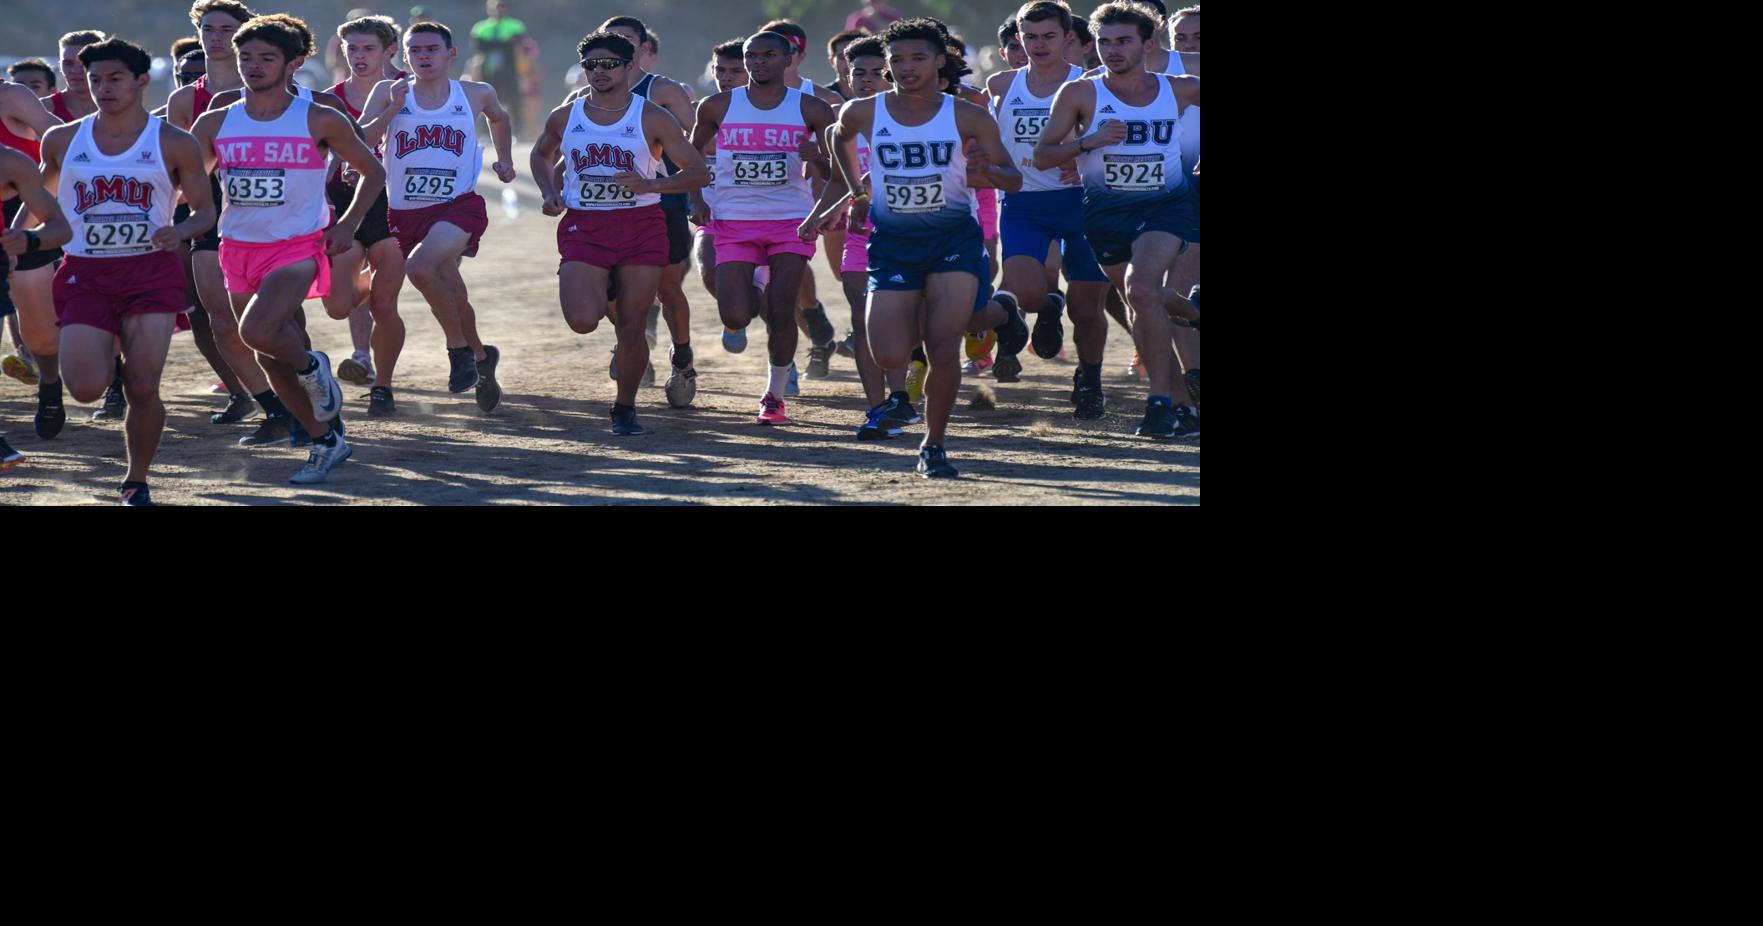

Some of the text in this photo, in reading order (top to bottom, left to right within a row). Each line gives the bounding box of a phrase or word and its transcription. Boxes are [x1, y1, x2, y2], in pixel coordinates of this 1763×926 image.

[395, 124, 466, 159] LMU
[722, 128, 804, 147] MT. SAC
[1098, 119, 1176, 146] BU
[218, 142, 311, 164] MT. SAC
[571, 143, 635, 174] LMU
[876, 141, 956, 170] CBU
[735, 161, 786, 179] 6343
[1106, 163, 1164, 184] 5924
[73, 175, 154, 215] LMU
[228, 177, 284, 199] 6353
[405, 176, 455, 196] 6295
[886, 184, 943, 206] 5932
[86, 223, 150, 246] 6292
